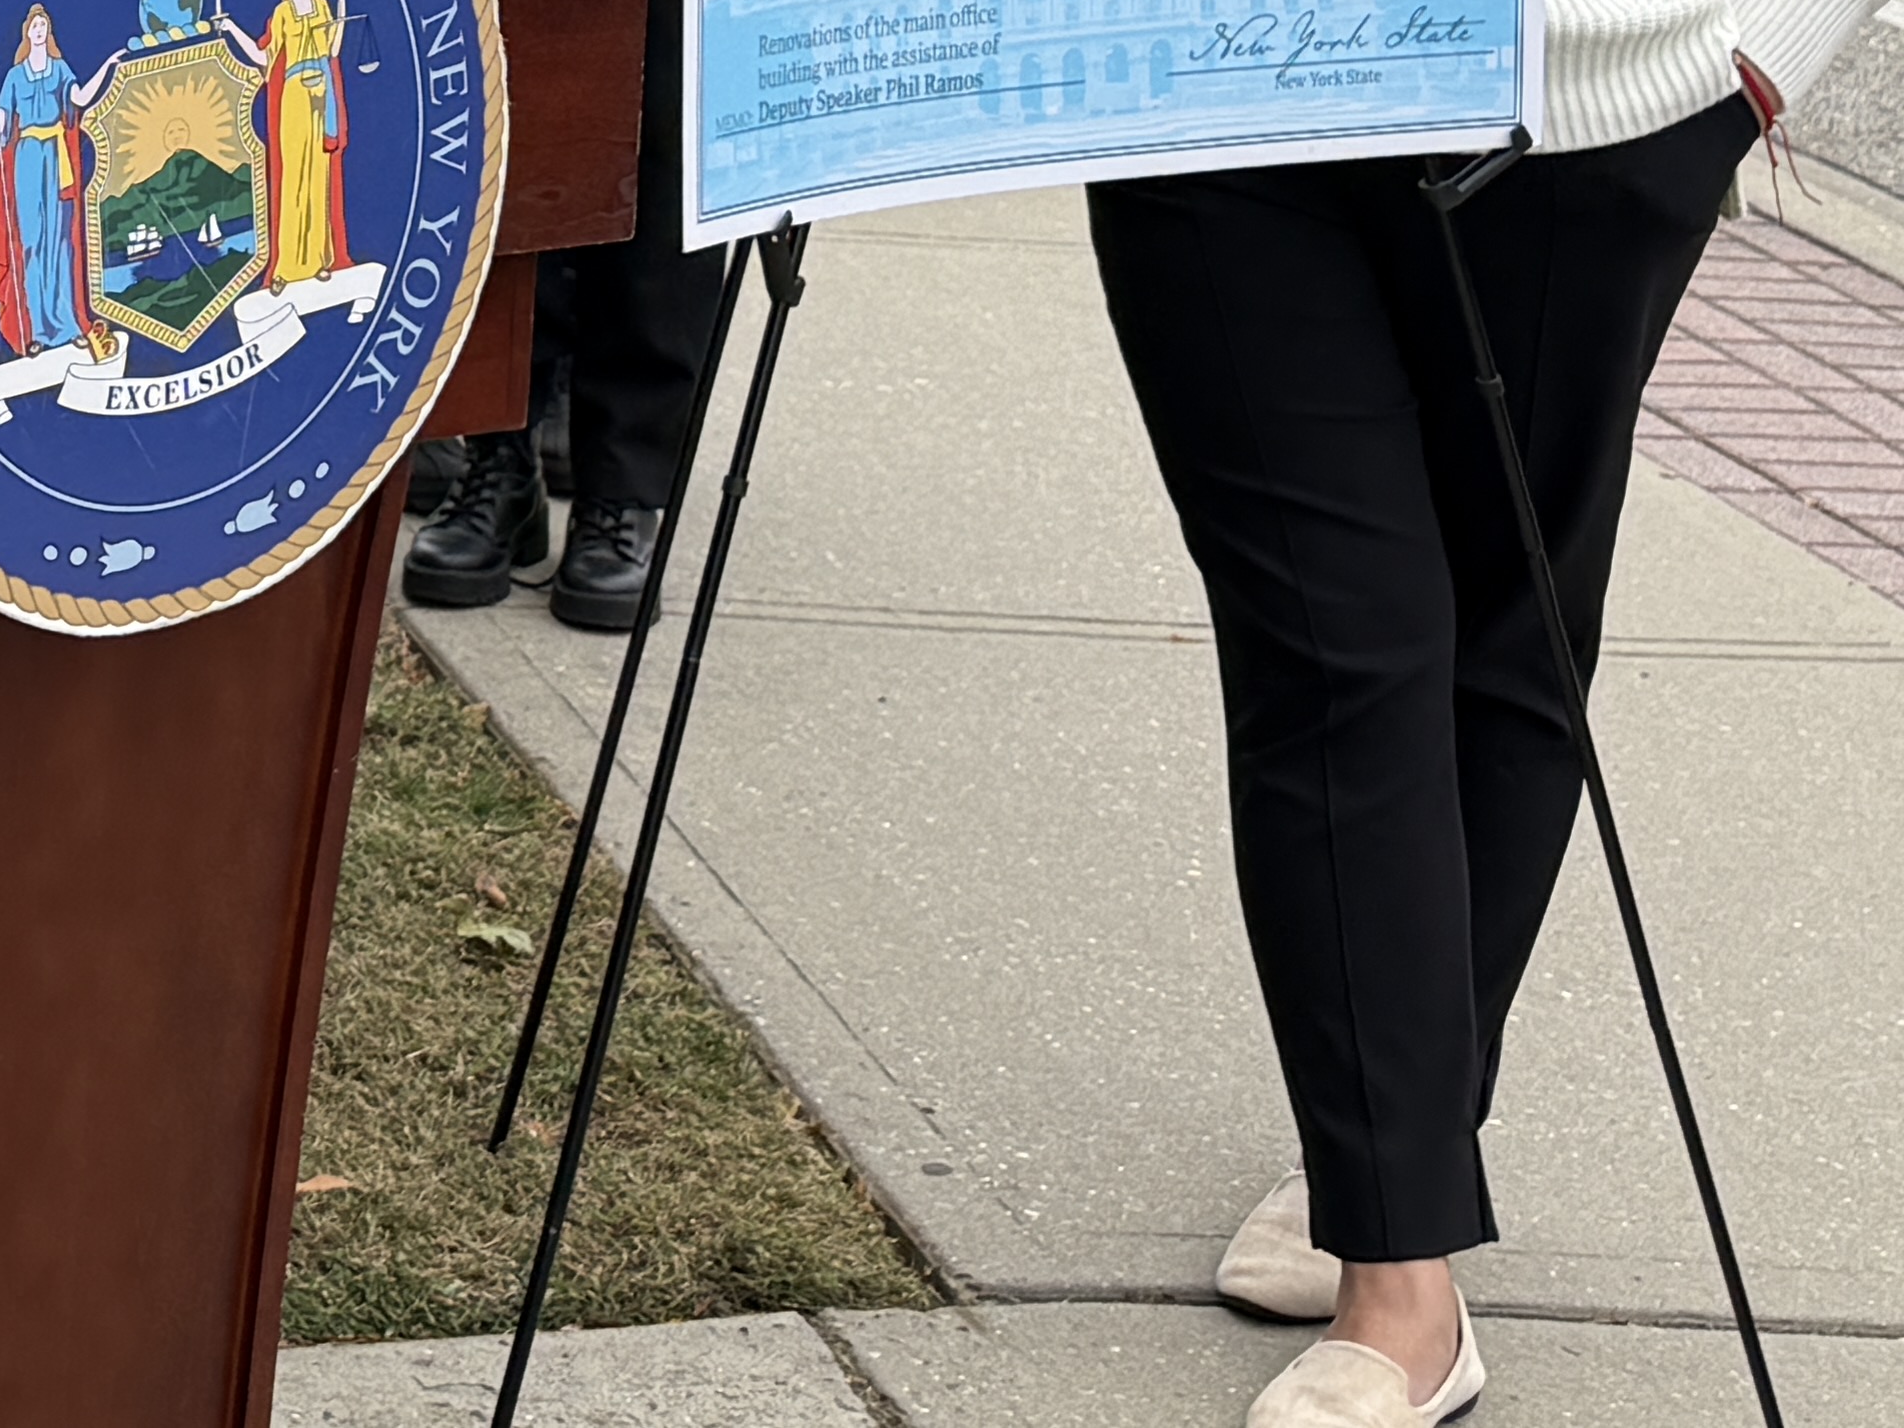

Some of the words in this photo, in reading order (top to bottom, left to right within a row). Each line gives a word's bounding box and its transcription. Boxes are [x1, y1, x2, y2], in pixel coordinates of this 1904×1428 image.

[758, 23, 852, 57] Renovations
[854, 15, 876, 41] of
[875, 14, 900, 37] the
[904, 9, 946, 35] main
[950, 3, 997, 27] office
[1189, 14, 1279, 62] New
[1278, 9, 1370, 75] York
[1385, 5, 1487, 49] State
[758, 58, 822, 89] building
[824, 52, 860, 77] with
[863, 47, 893, 72] the
[892, 38, 979, 67] assistance
[981, 32, 1002, 55] of
[1274, 73, 1306, 91] New
[1310, 69, 1344, 87] York
[1347, 69, 1382, 86] State
[758, 94, 813, 124] Deputy
[816, 83, 882, 112] Speaker
[886, 75, 920, 101] Phil
[924, 71, 984, 95] Ramos
[346, 212, 460, 415] YORK
[105, 343, 264, 410] EXCELSIOR
